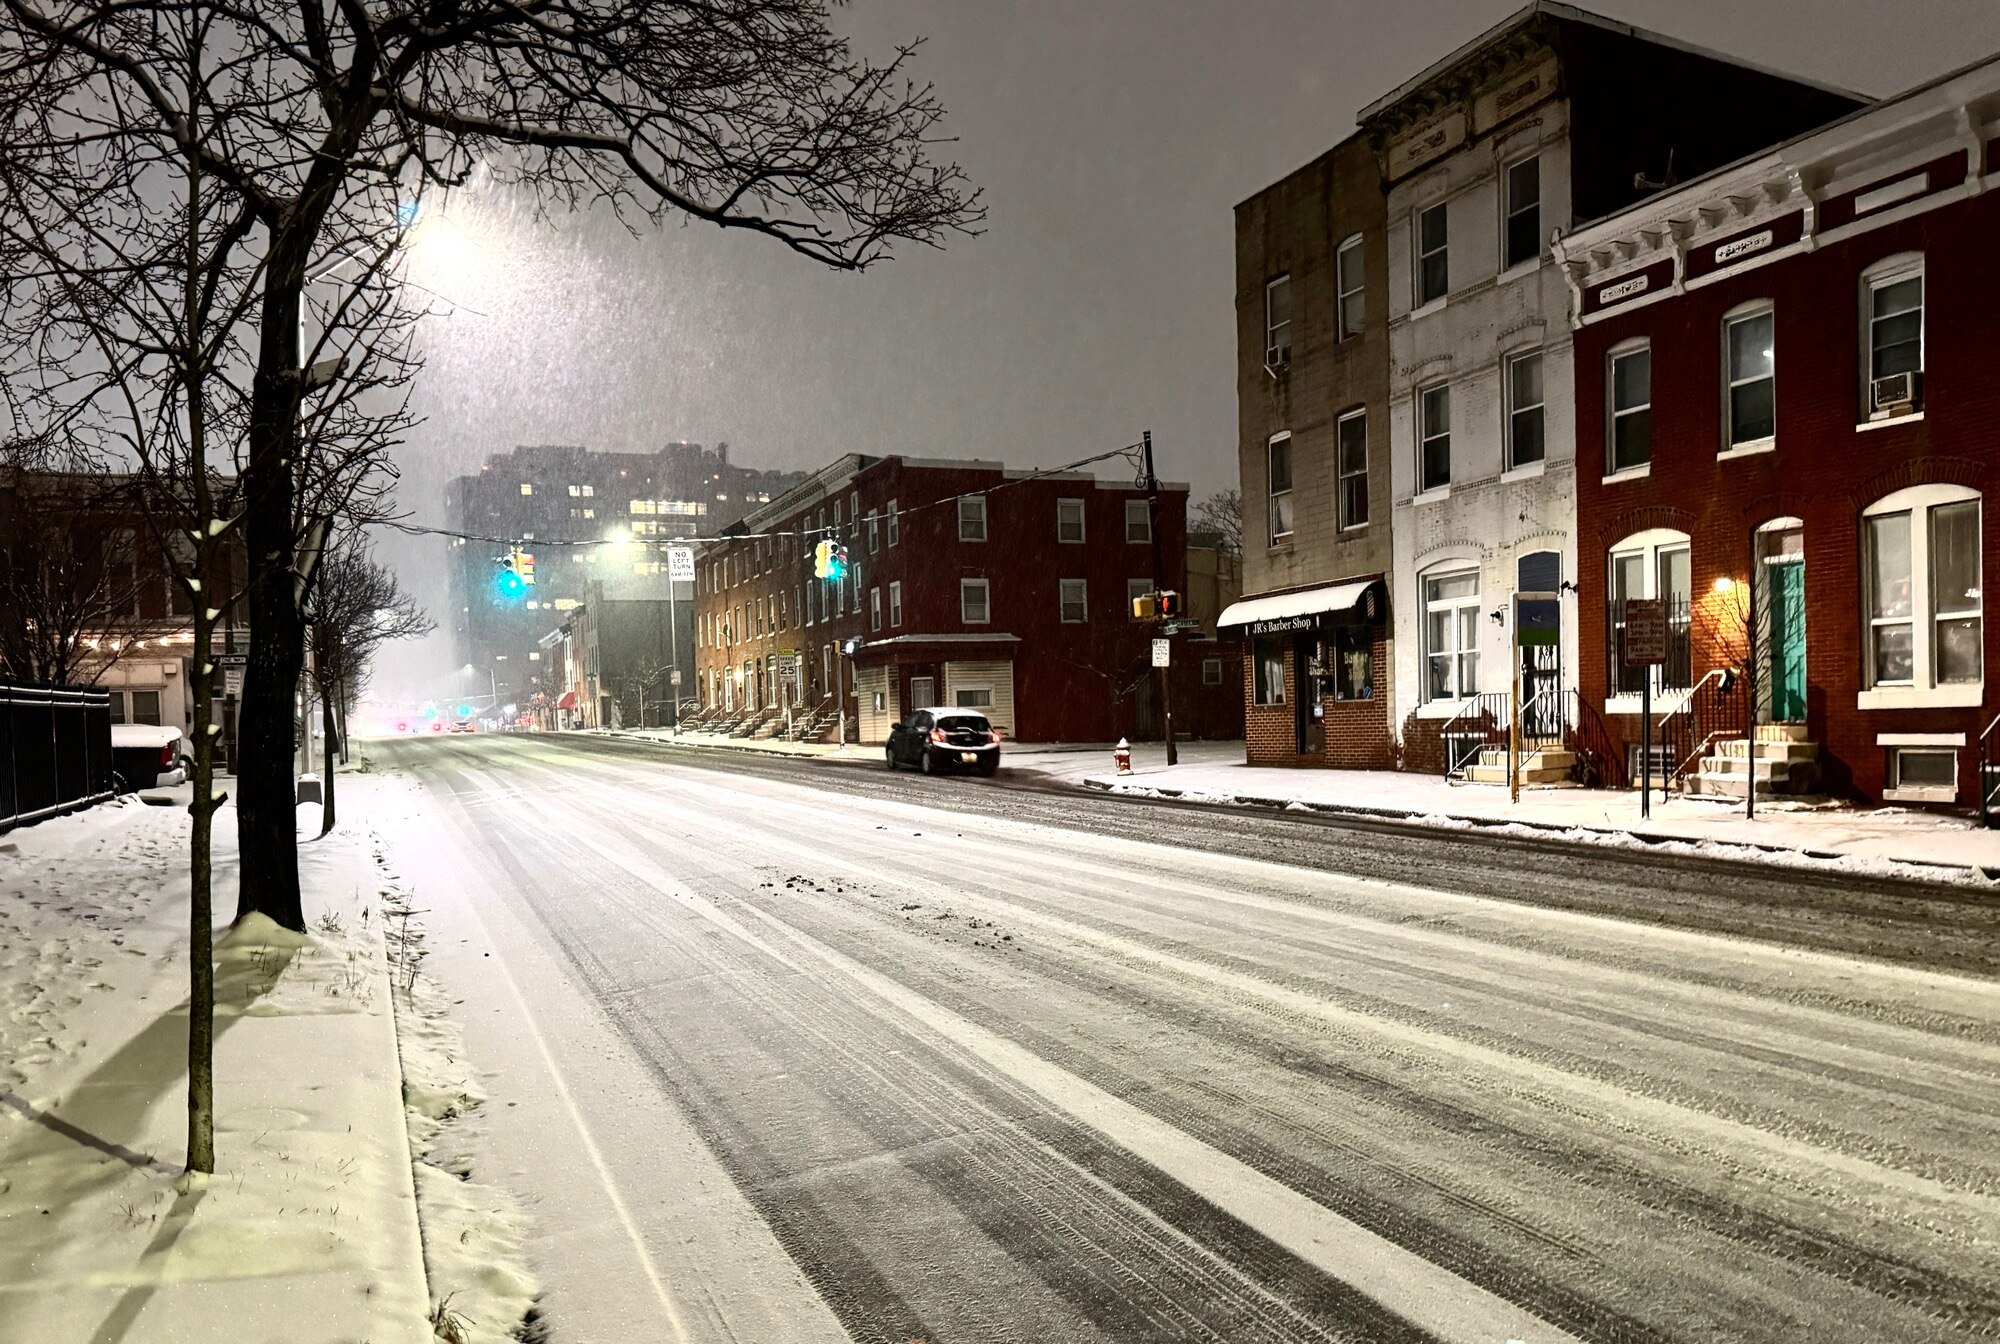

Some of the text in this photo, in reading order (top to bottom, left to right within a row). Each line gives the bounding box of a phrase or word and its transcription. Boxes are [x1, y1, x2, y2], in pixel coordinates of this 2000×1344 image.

[1252, 617, 1312, 634] JR's Barber Shop
[780, 666, 794, 674] 25
